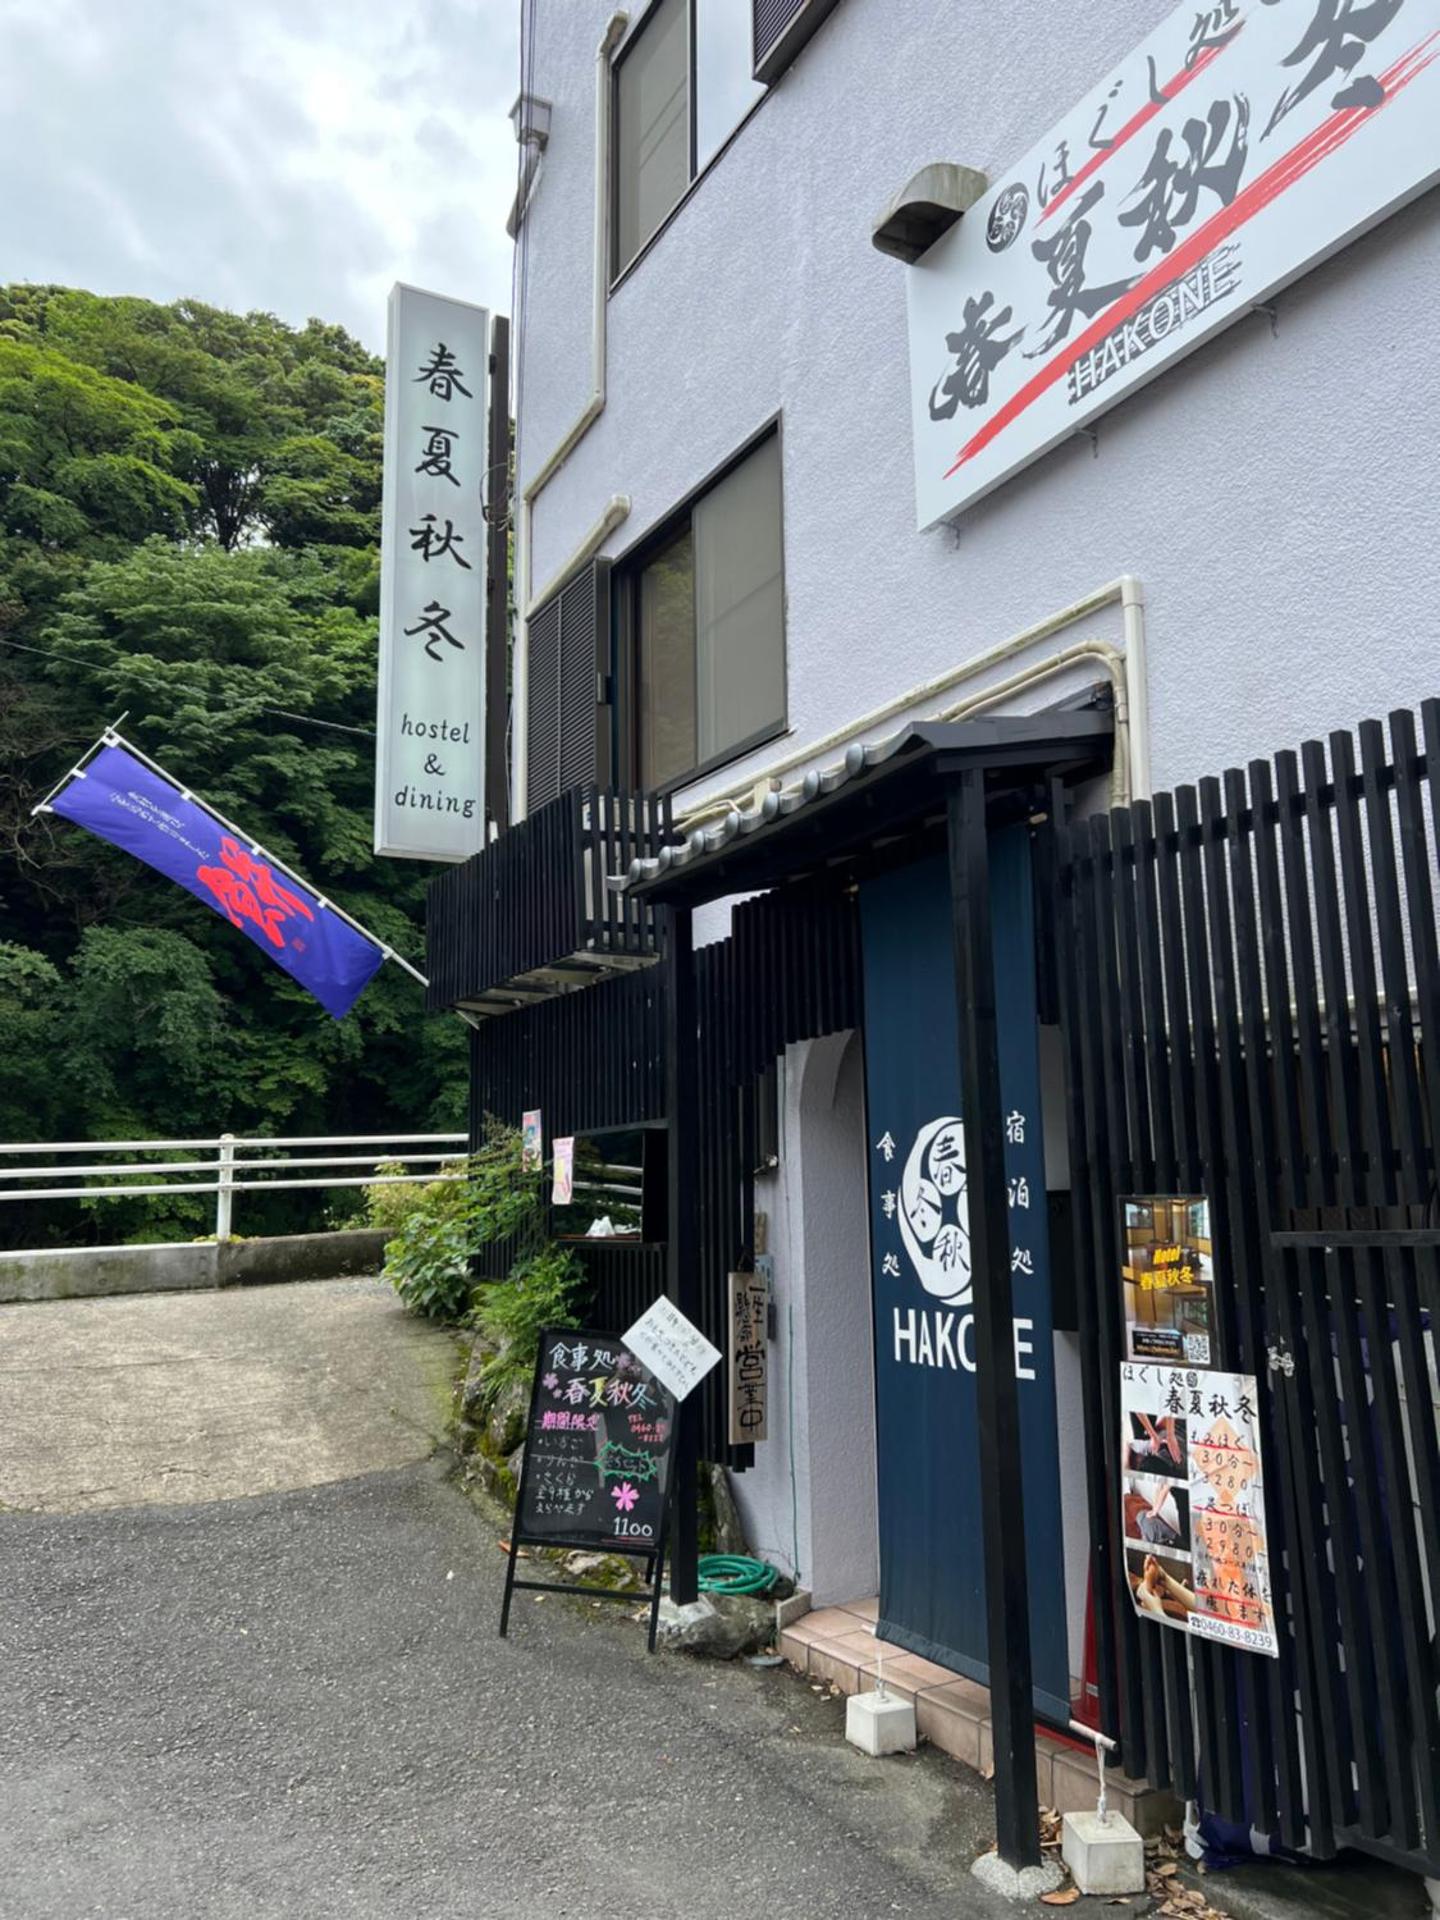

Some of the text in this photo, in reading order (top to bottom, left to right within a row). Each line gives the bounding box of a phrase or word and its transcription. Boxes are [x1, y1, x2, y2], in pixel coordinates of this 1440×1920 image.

[1071, 246, 1241, 403] HAKONE
[404, 342, 473, 662] 春夏秋冬
[401, 713, 470, 744] hostel
[423, 753, 446, 776] &
[395, 785, 477, 819] dining
[875, 1131, 901, 1277] 食事処
[1004, 1110, 1035, 1275] 宿泊処
[549, 1341, 617, 1372] 食事処
[562, 1376, 657, 1410] 春夏秋冬
[1123, 1365, 1185, 1388] ほぐし処
[1164, 1386, 1257, 1425] 春夏秋冬
[613, 1516, 653, 1537] 1100
